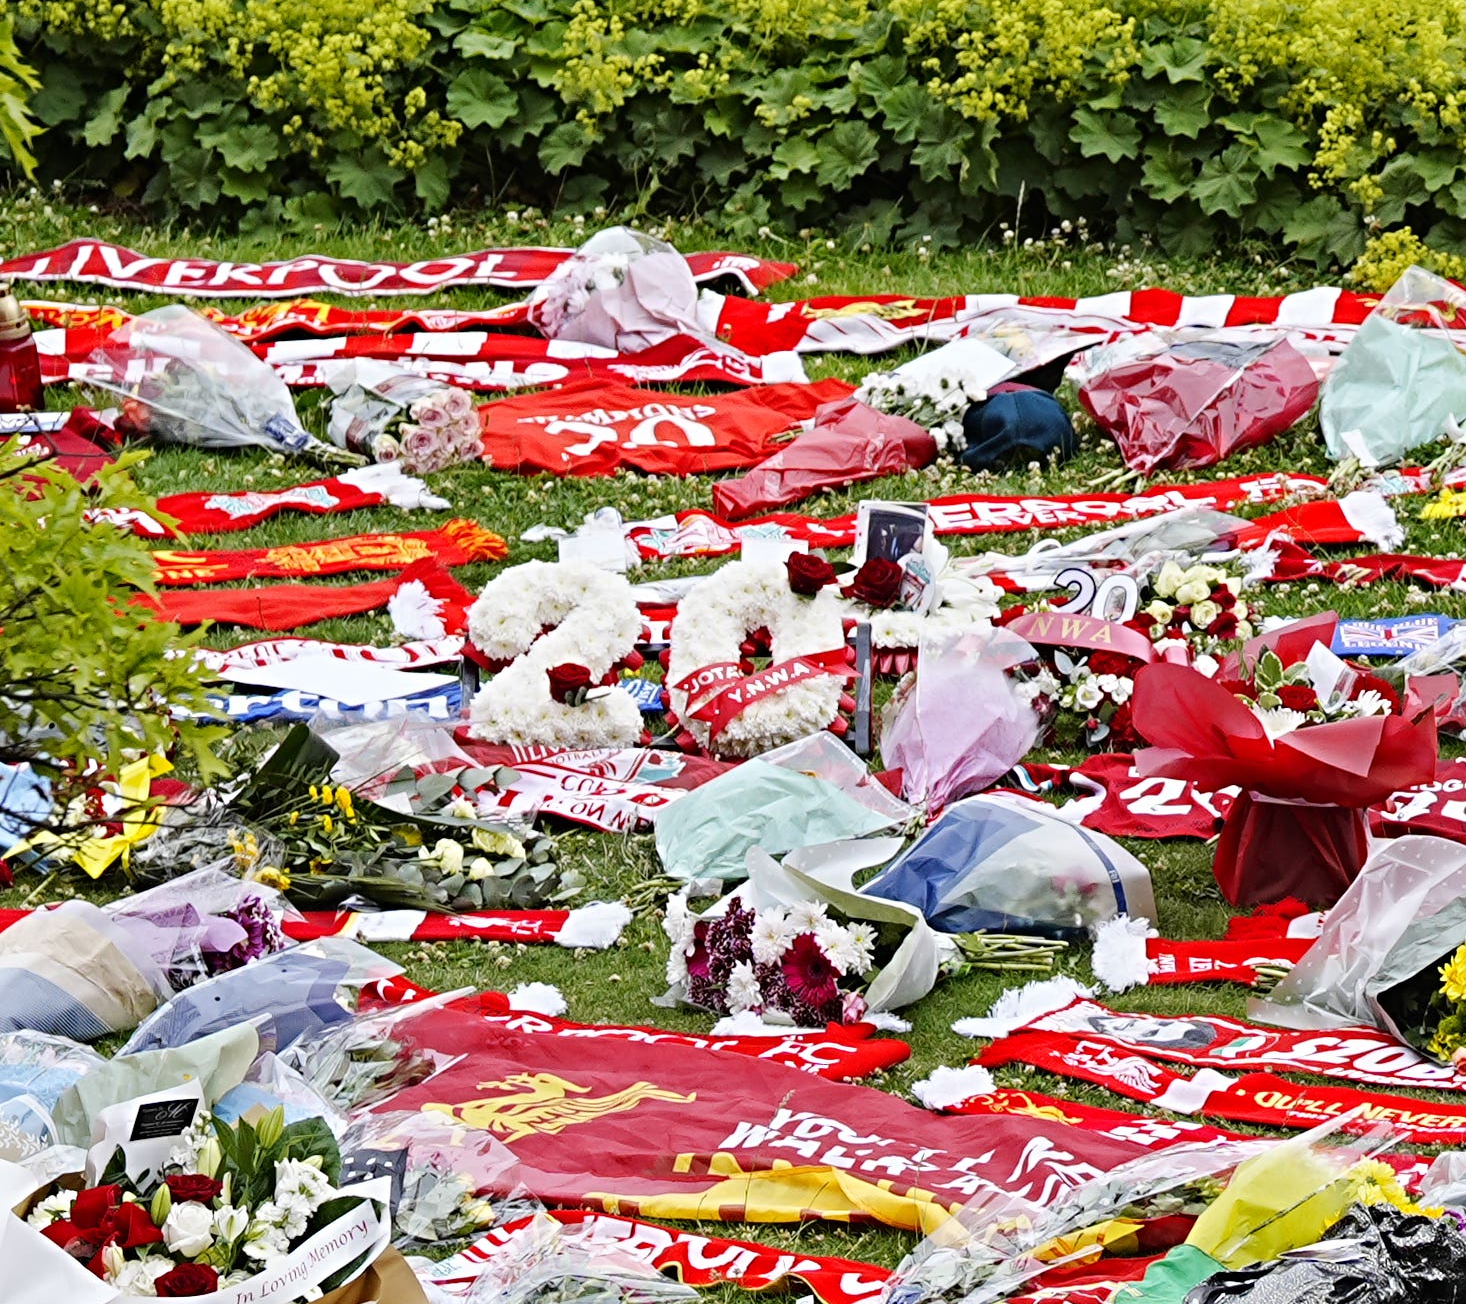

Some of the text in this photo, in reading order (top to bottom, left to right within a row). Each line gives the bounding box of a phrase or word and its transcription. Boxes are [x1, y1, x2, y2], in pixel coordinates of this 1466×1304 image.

[18, 242, 522, 290] LIVERPOOL
[931, 489, 1218, 531] ERPOOL
[1050, 568, 1138, 624] 20
[1031, 617, 1113, 646] NWA
[690, 664, 740, 694] JOTA
[1253, 1089, 1344, 1115] OU'LL
[260, 1254, 311, 1298] Loving
[308, 1216, 370, 1268] Memory
